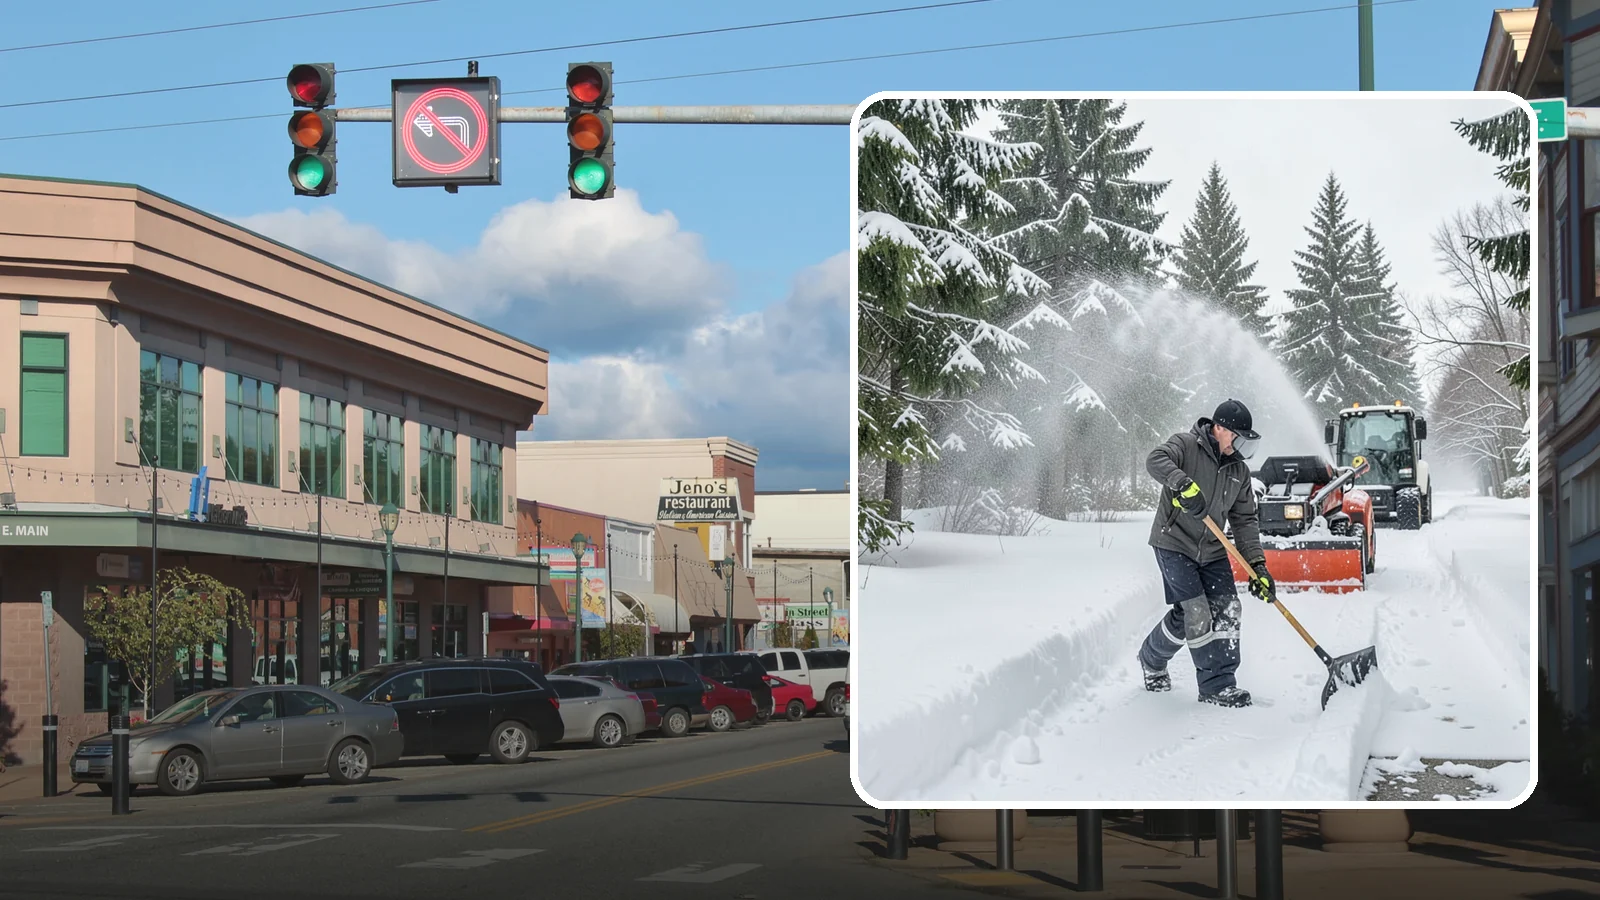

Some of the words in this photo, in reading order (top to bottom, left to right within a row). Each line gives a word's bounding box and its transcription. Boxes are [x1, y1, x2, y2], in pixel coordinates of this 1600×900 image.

[670, 480, 727, 494] Jeno's
[665, 496, 731, 509] restaurant
[658, 510, 682, 519] Italian
[686, 510, 715, 519] American
[715, 510, 737, 519] Cuisine
[2, 525, 13, 536] E.
[15, 525, 49, 536] MAIN
[797, 608, 828, 616] Street
